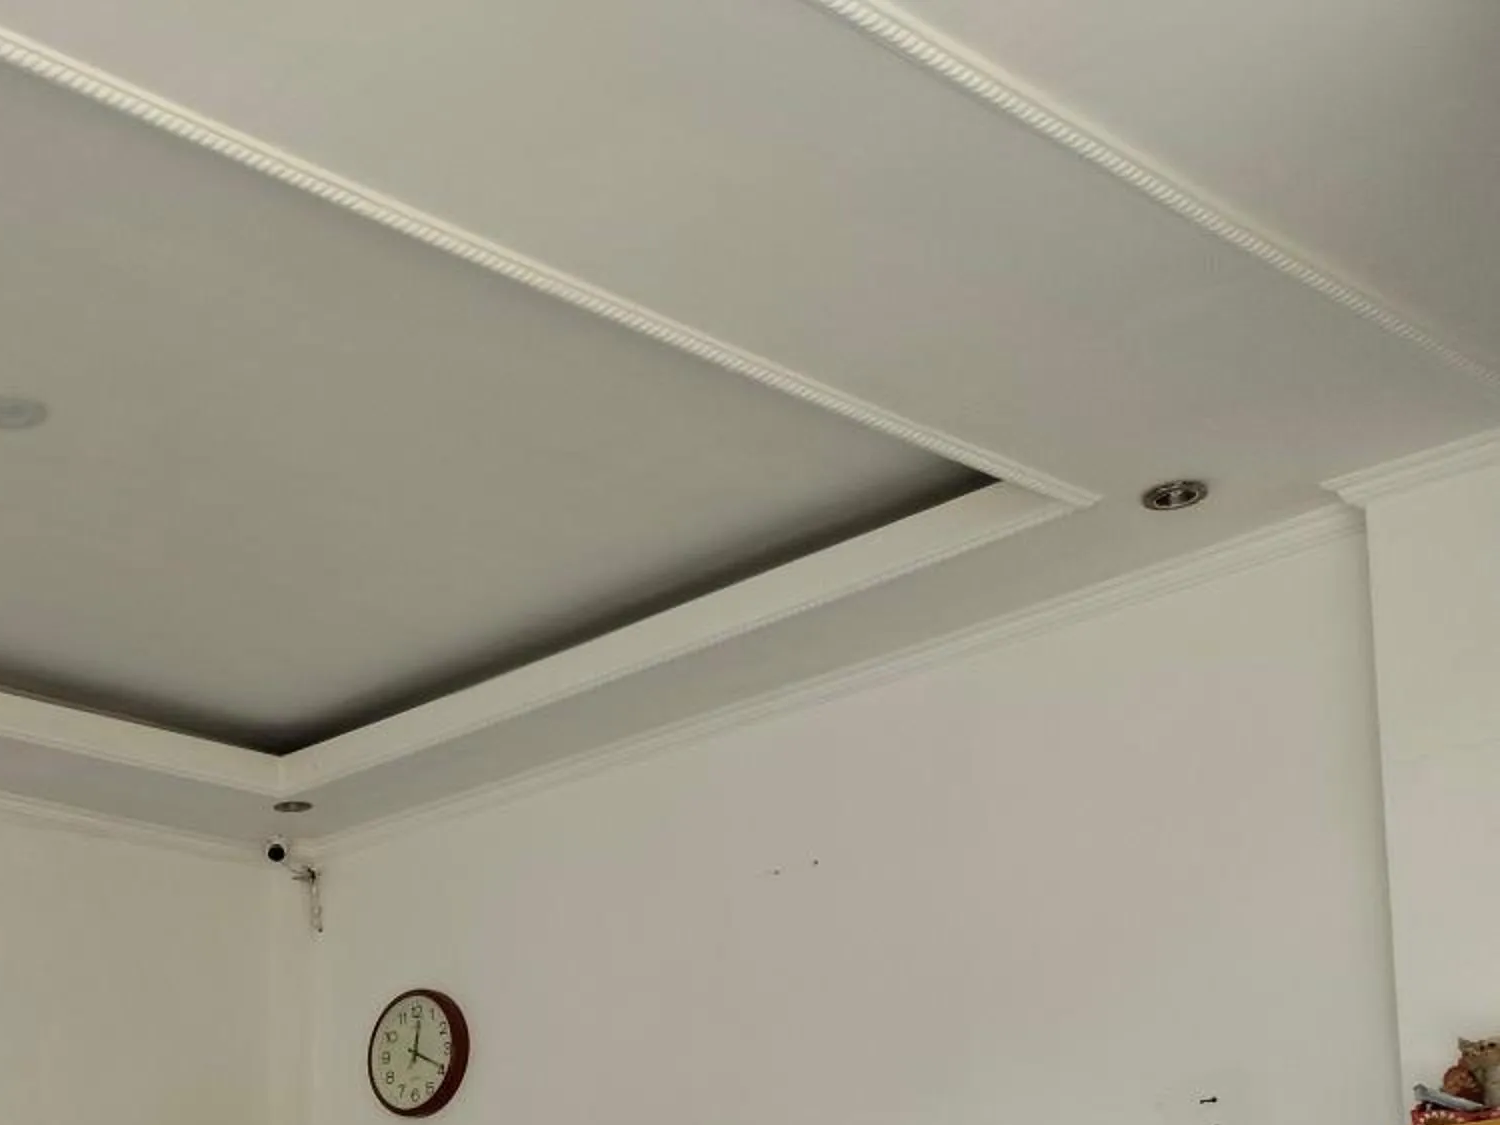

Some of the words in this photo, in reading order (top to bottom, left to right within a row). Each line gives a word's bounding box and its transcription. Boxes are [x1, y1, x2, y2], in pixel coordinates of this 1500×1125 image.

[440, 1021, 447, 1035] 2
[444, 1042, 452, 1056] 3
[381, 1052, 391, 1065] 9
[386, 1071, 395, 1084] 8
[398, 1083, 405, 1098] 7
[411, 1088, 420, 1102] 6
[425, 1082, 434, 1094] 5
